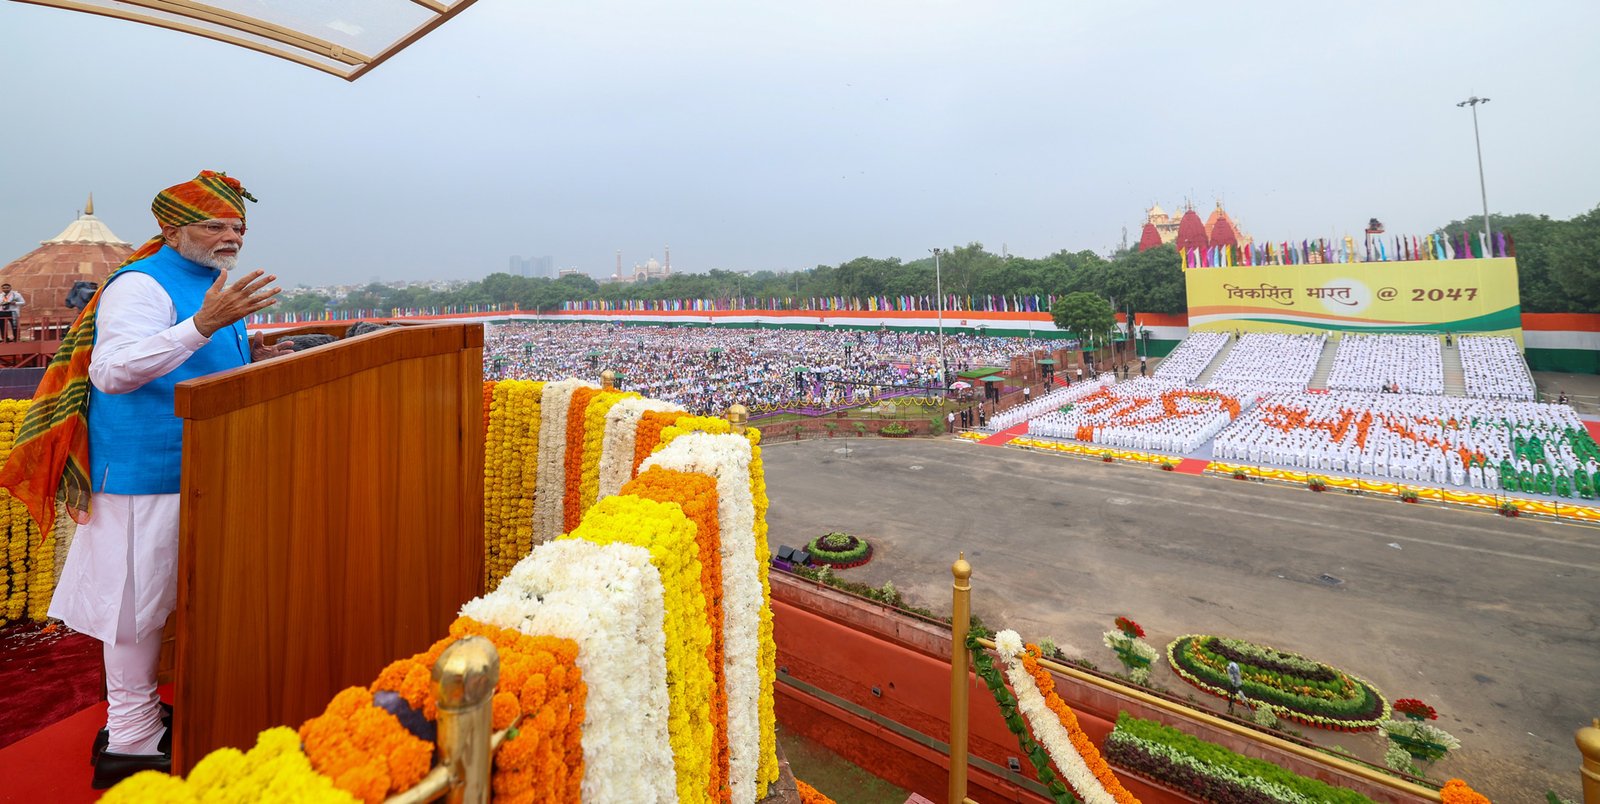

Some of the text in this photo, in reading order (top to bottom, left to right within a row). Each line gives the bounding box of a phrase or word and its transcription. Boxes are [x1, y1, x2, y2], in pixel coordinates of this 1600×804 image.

[1306, 287, 1358, 306] भारत
[1377, 287, 1398, 301] @
[1411, 287, 1478, 302] 2047
